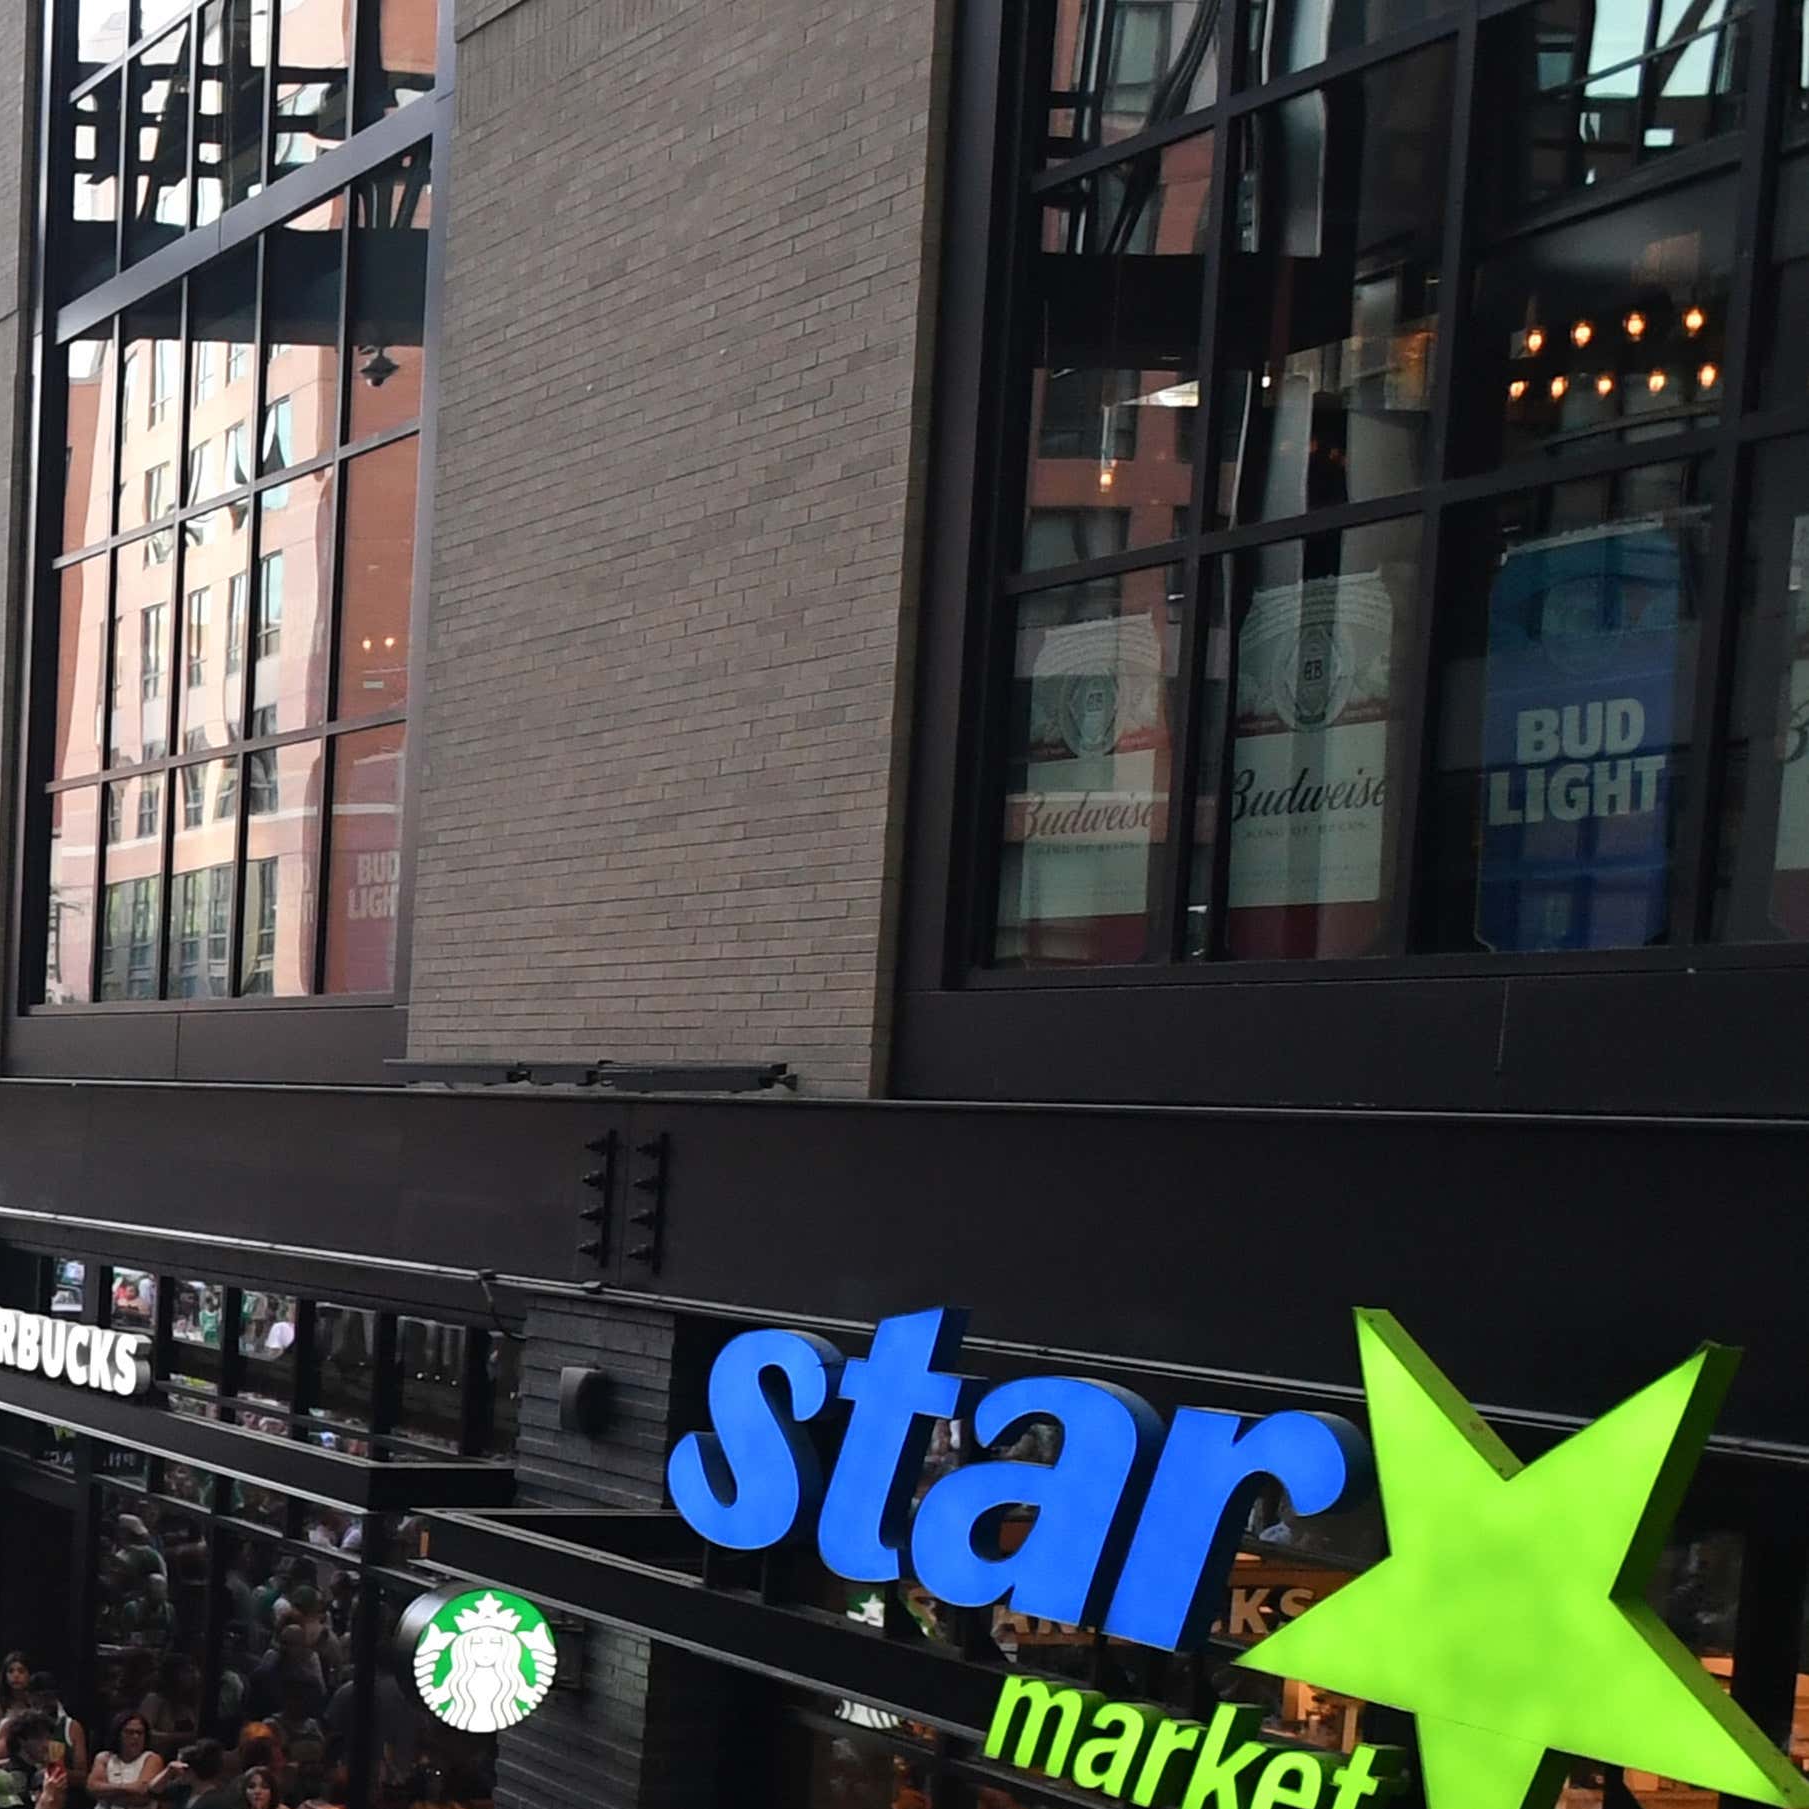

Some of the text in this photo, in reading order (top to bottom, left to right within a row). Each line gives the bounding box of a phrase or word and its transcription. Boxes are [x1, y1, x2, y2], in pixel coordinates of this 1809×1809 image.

[1516, 698, 1645, 766] BUD
[1488, 754, 1666, 826] LIGHT
[666, 1305, 1362, 1652] star
